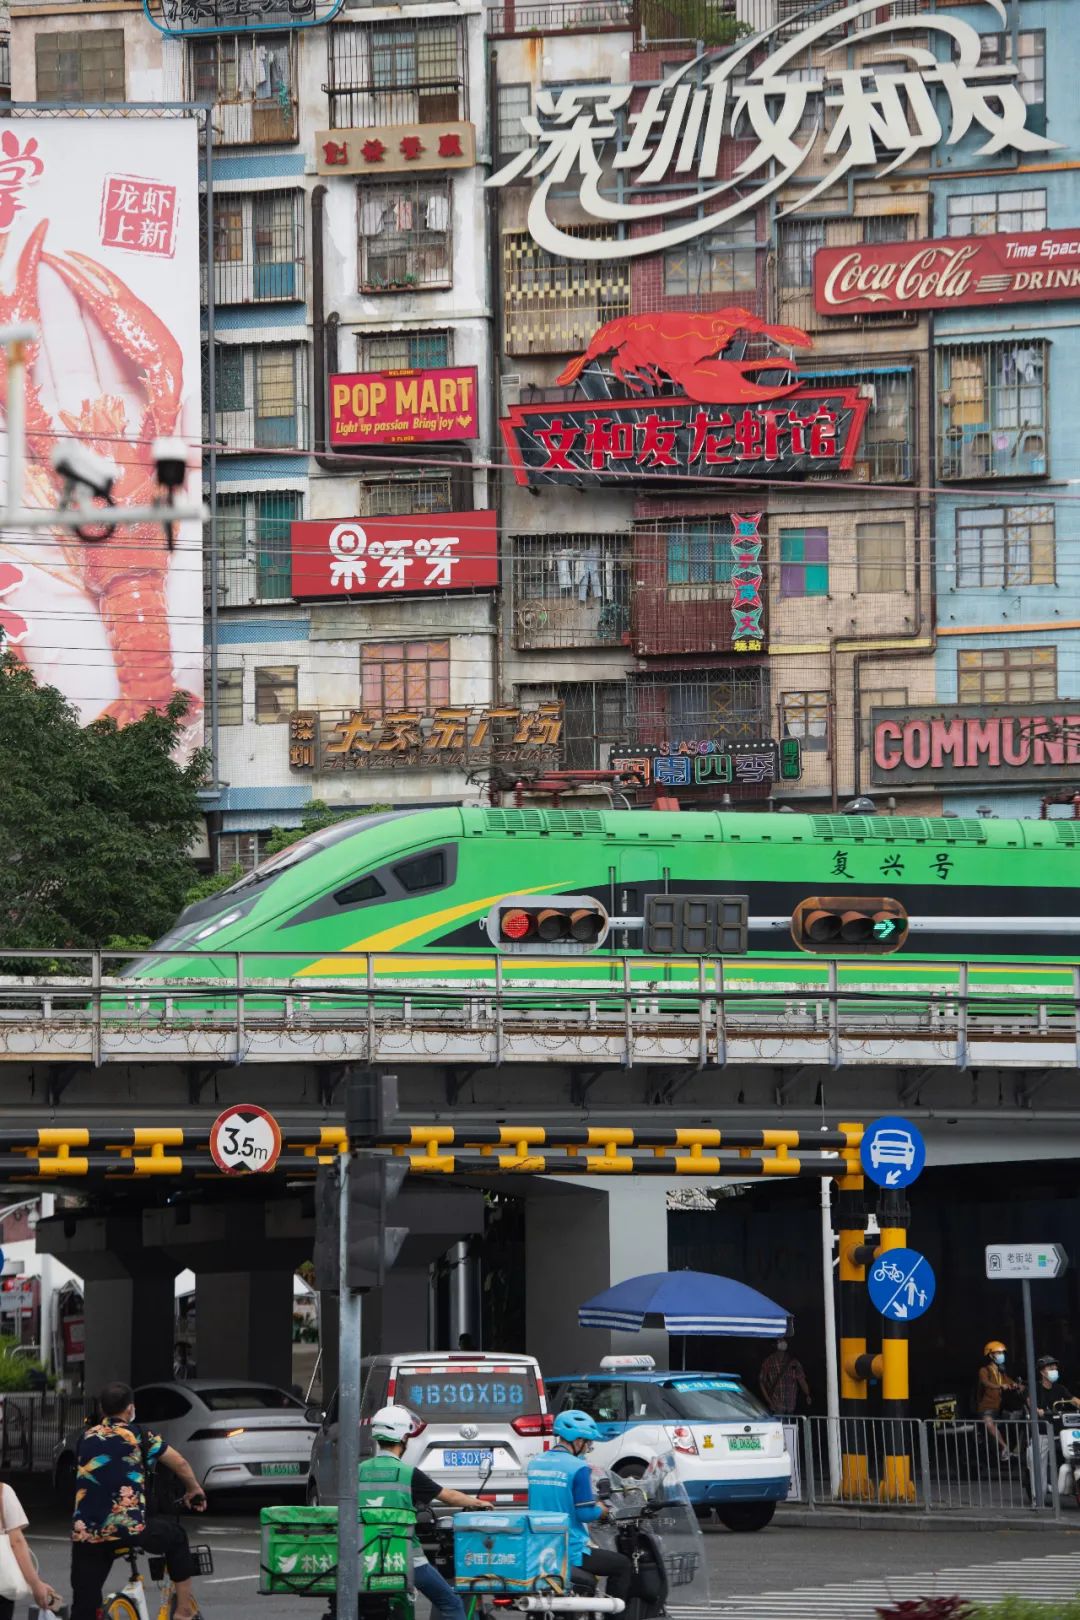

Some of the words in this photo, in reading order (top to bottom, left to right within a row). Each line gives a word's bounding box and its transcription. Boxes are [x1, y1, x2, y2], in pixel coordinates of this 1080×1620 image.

[484, 10, 1068, 240] 深圳文和友
[110, 183, 172, 217] 龙虾
[107, 215, 169, 249] 上新
[1006, 242, 1037, 258] Time
[1040, 239, 1080, 260] Spac
[333, 382, 387, 419] POP
[395, 377, 473, 416] MART
[335, 420, 358, 437] Light
[360, 422, 372, 435] up
[374, 418, 409, 434] passion
[413, 417, 437, 432] Bring
[533, 405, 838, 471] 文和友龙虾馆
[329, 523, 460, 590] 果呀呀
[326, 700, 564, 753] 大家乐广场
[830, 850, 954, 880] 复兴号
[223, 1126, 268, 1160] 3.5m
[1007, 1251, 1033, 1264] 老街站
